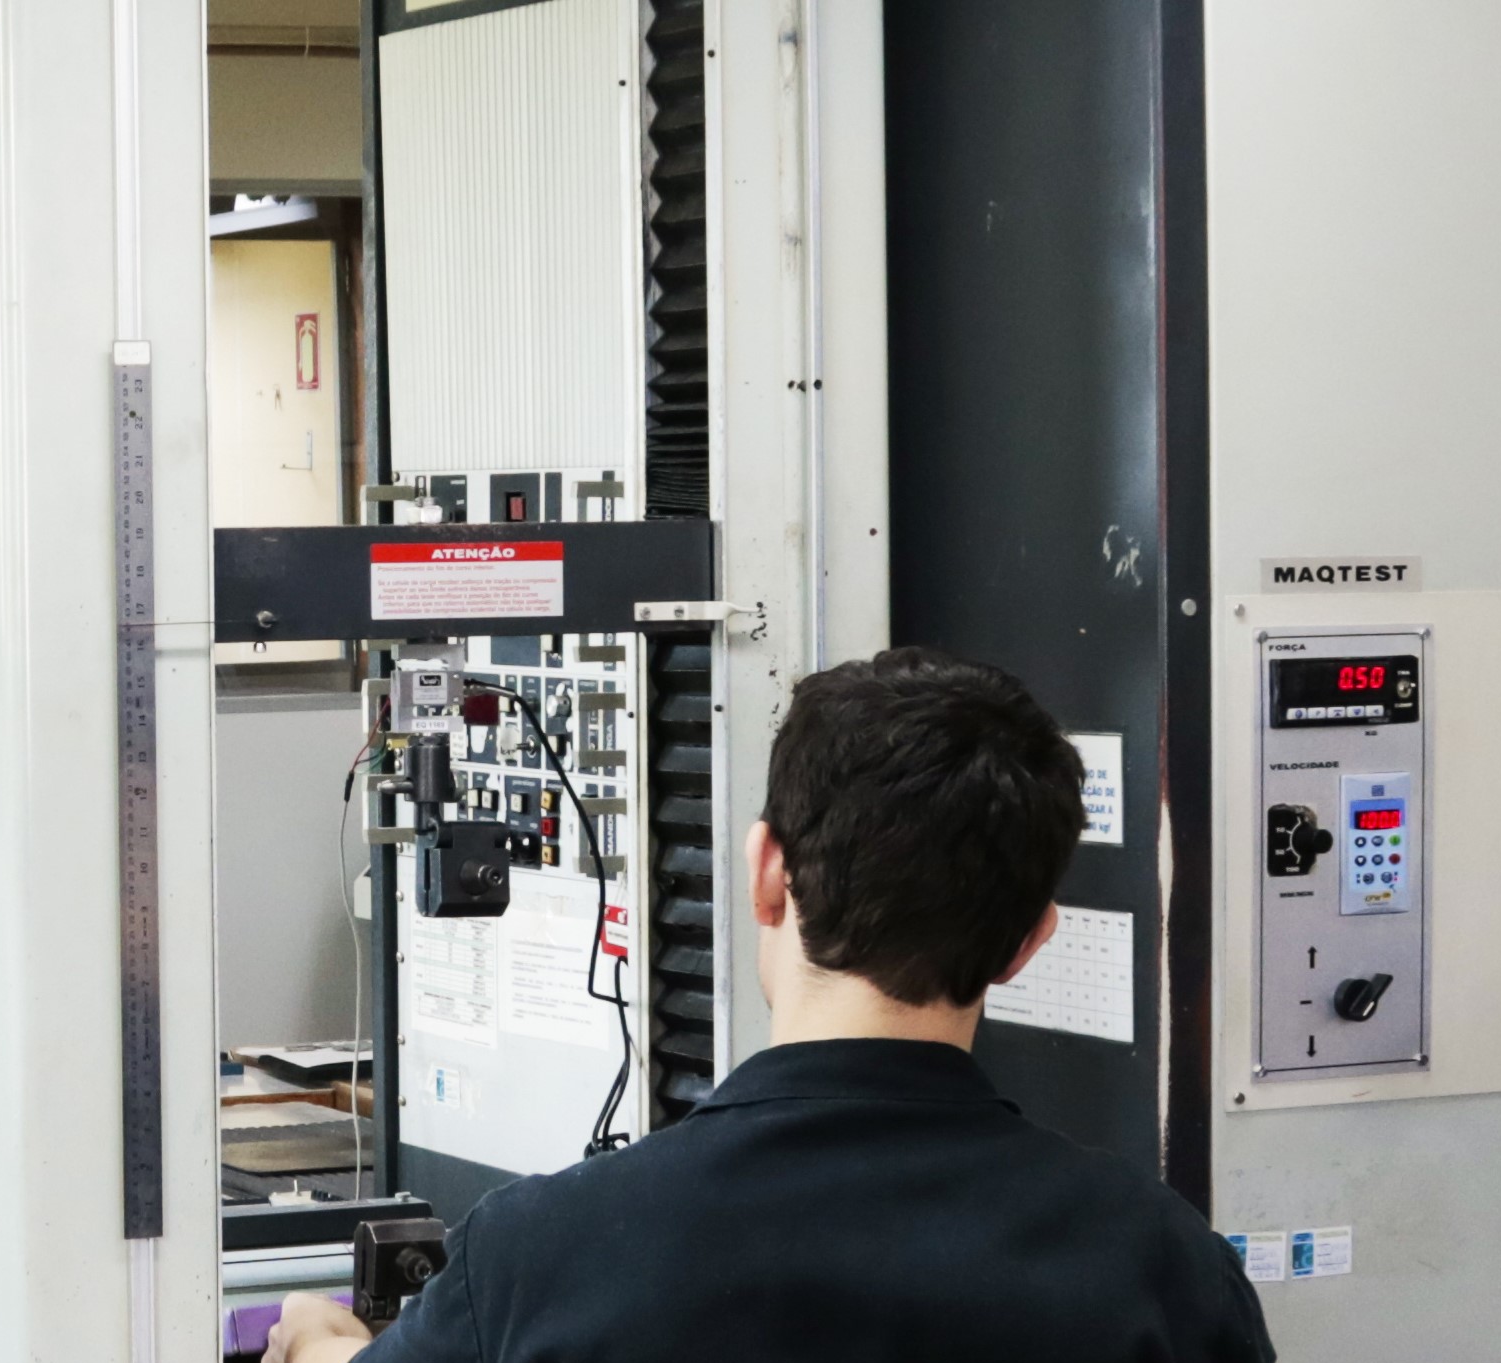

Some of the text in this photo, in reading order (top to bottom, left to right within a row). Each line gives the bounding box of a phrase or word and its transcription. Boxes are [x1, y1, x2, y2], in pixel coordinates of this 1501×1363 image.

[431, 546, 516, 561] ATENÇÃO
[1274, 565, 1407, 584] MAQTEST
[1269, 644, 1307, 653] FORÇA
[1269, 761, 1340, 771] VELOCIDADE
